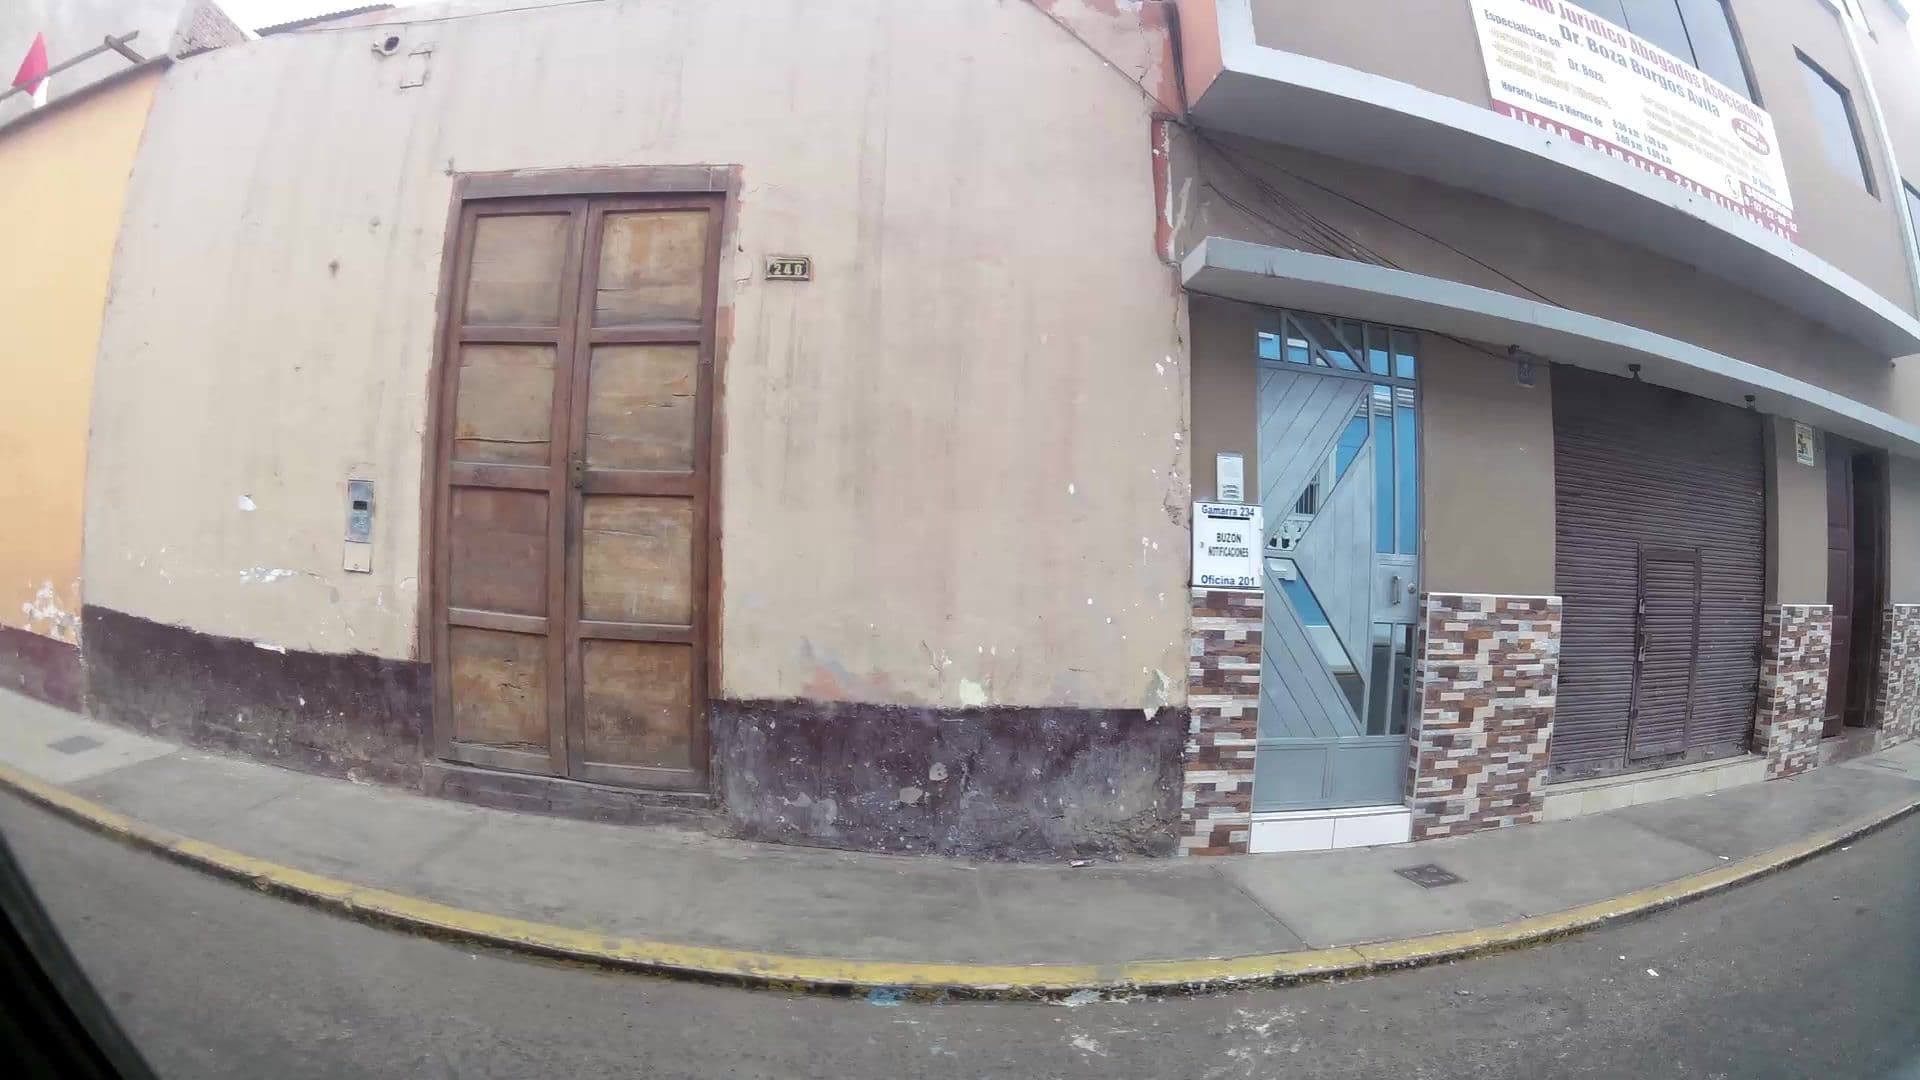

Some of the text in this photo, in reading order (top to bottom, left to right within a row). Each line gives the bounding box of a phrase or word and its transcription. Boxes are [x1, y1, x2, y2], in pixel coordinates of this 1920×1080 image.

[1558, 24, 1584, 47] Dr.
[1585, 36, 1628, 68] Boza
[1629, 57, 1686, 98] Burgos
[1629, 37, 1702, 89] Abogados
[1201, 504, 1255, 517] Gamarra 234
[1207, 546, 1249, 558] NOTIFICACIONES
[1201, 574, 1255, 586] Oficina 201
